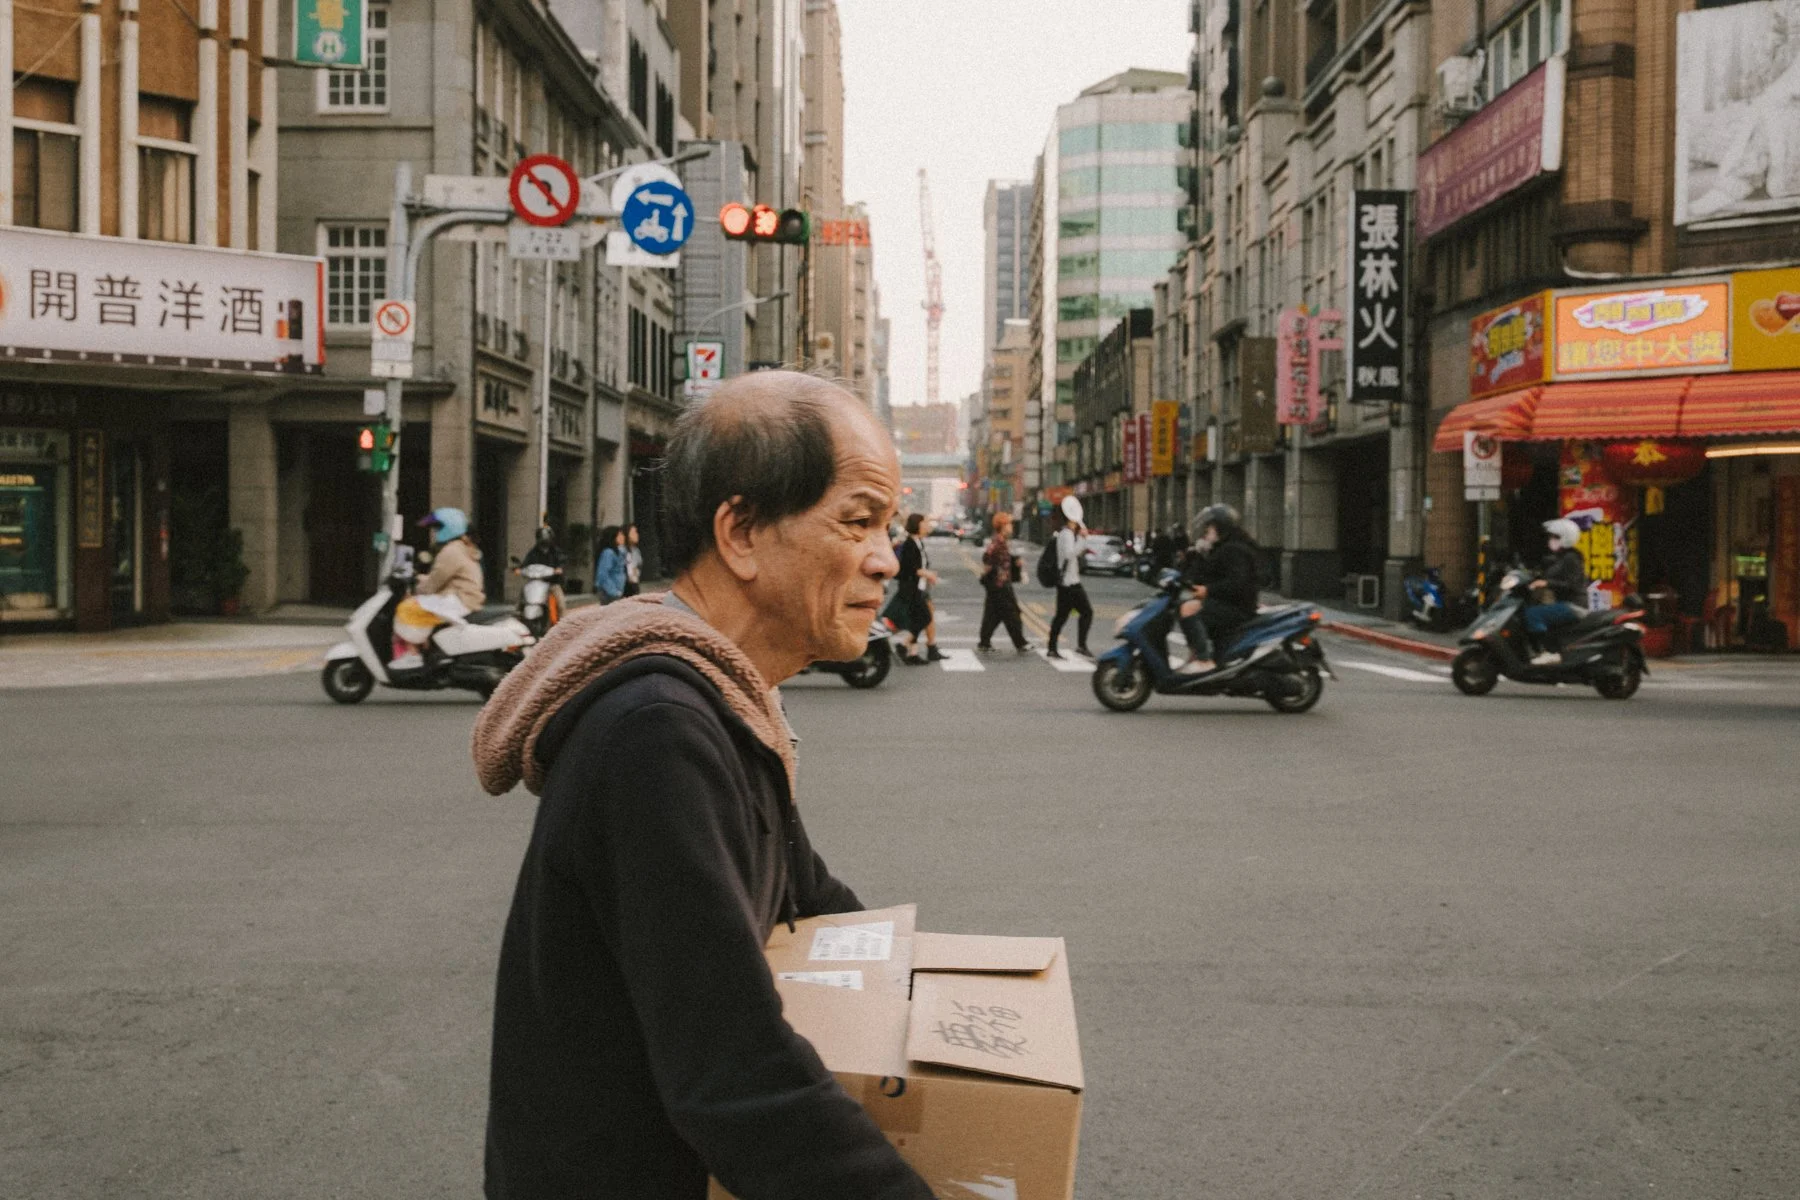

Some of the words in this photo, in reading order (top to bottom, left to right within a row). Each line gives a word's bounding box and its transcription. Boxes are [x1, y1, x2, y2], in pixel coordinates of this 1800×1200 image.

[29, 268, 264, 336] 開普洋酒
[1359, 204, 1399, 349] 張林火
